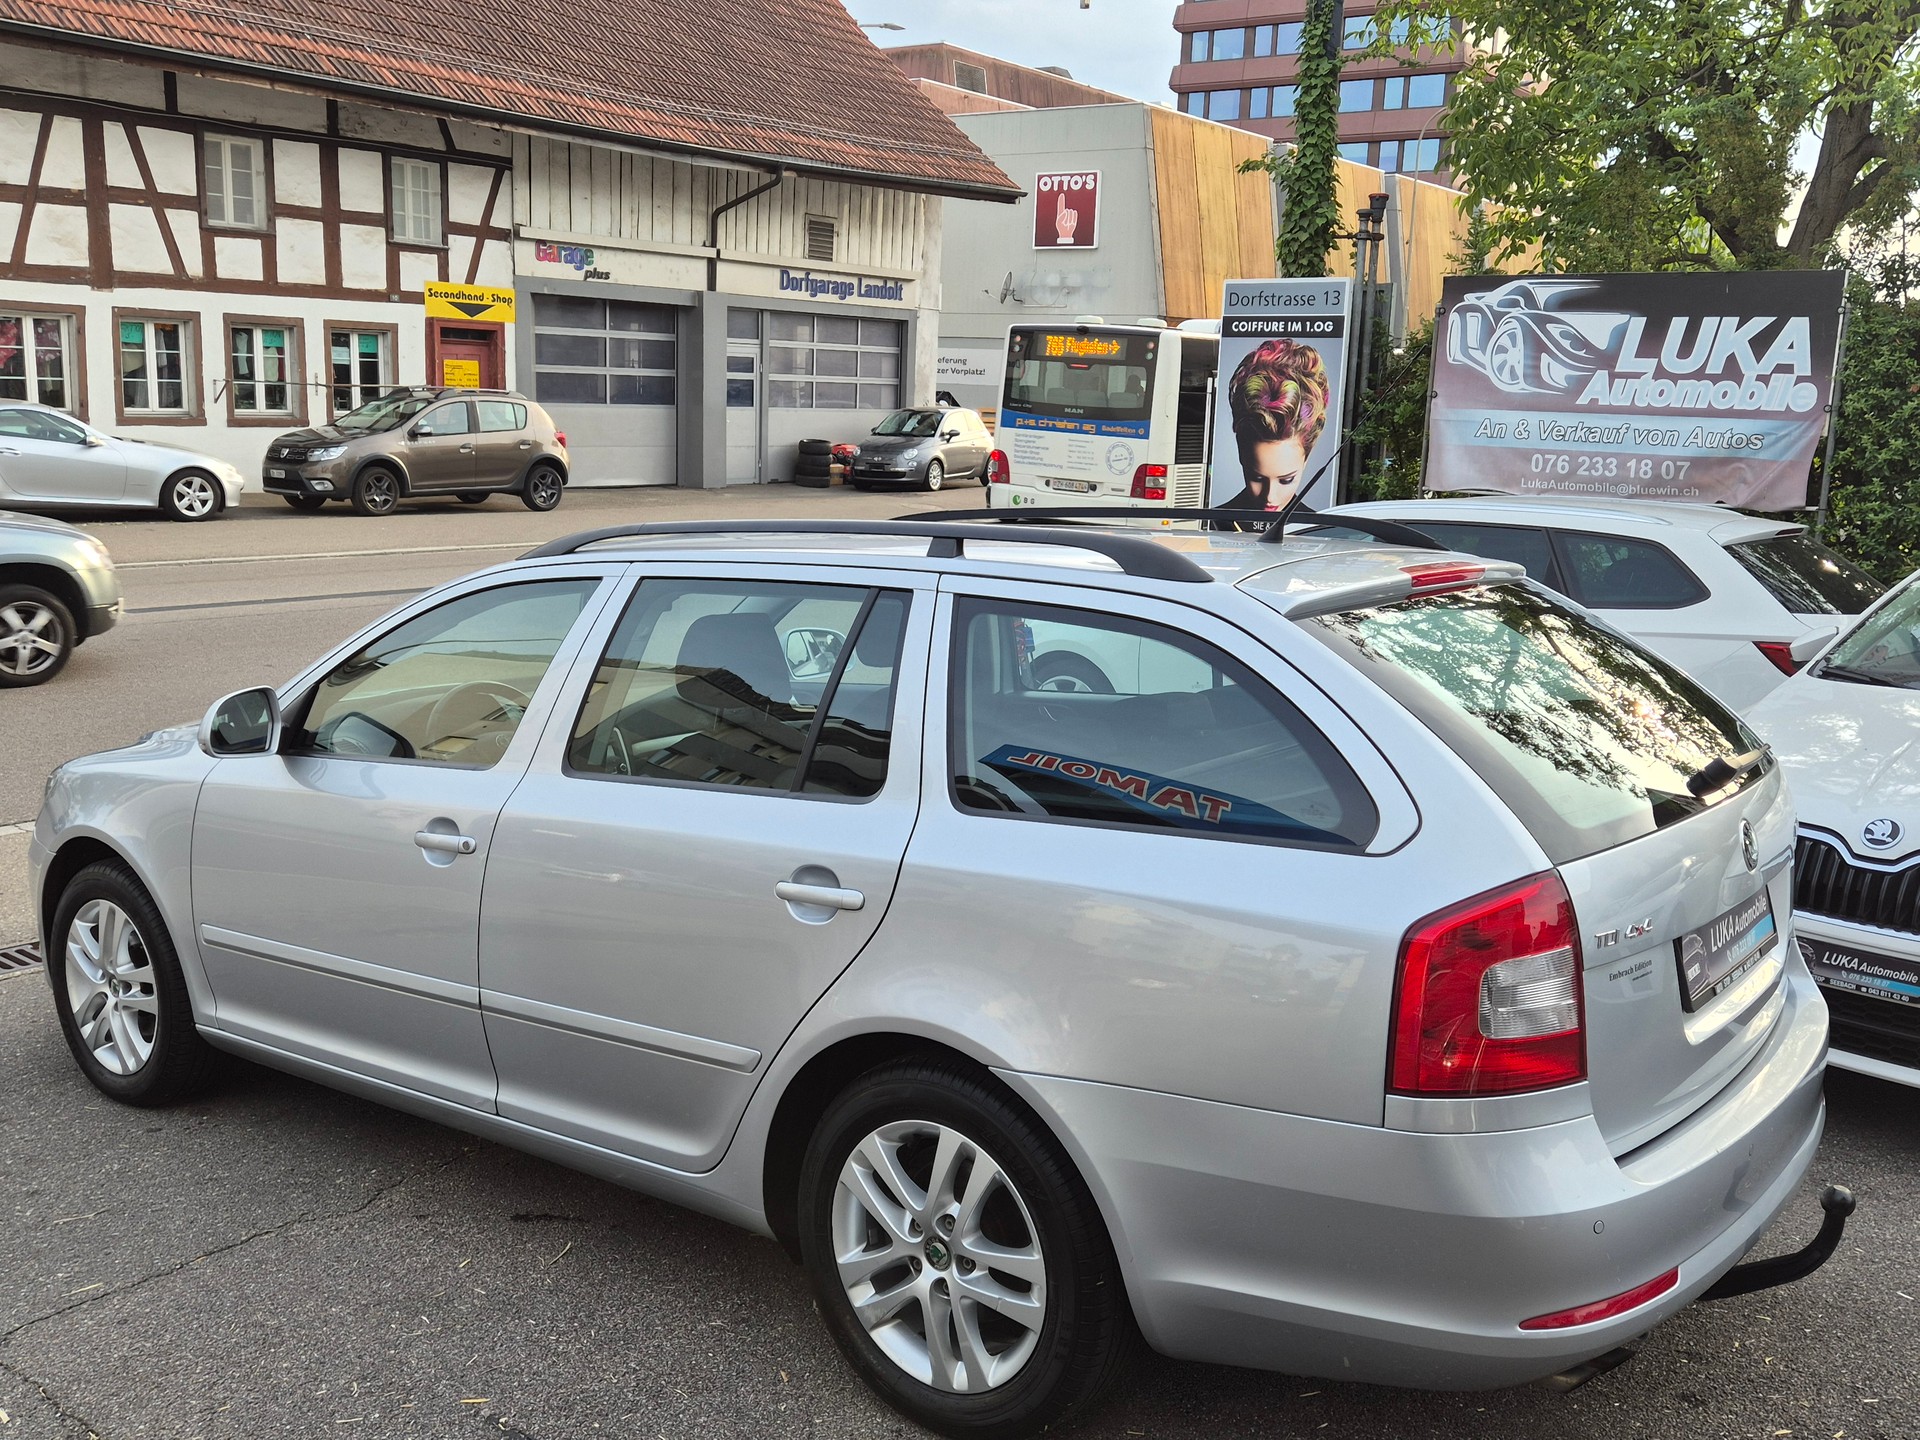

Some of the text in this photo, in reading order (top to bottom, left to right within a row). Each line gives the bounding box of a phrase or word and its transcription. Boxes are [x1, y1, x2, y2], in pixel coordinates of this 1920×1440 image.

[1039, 174, 1095, 191] OTTO'S
[535, 240, 594, 271] Garage
[584, 267, 611, 281] plus
[780, 269, 903, 301] Dorfgarage Landolt
[428, 288, 485, 302] Secondhand
[491, 294, 513, 308] Shop
[1229, 290, 1341, 306] Dorfstrasse 13
[1232, 322, 1334, 332] COIFFURE IM 1.OG
[1615, 316, 1812, 376] LUKA
[950, 367, 986, 376] Vorplatz!
[1576, 370, 1818, 412] Automobile
[1475, 418, 1765, 450] An & Verkauf von Autos
[1531, 454, 1691, 480] 076 233 18 07
[1521, 478, 1699, 497] LukaAutomobile@bluewin.ch
[1253, 521, 1264, 530] SIE
[1710, 895, 1767, 953] LUKA Automobile
[1609, 966, 1634, 981] Embrach
[1634, 960, 1652, 972] Edition
[1822, 951, 1919, 983] LUKA Automobile
[1830, 979, 1857, 990] SEEBACH
